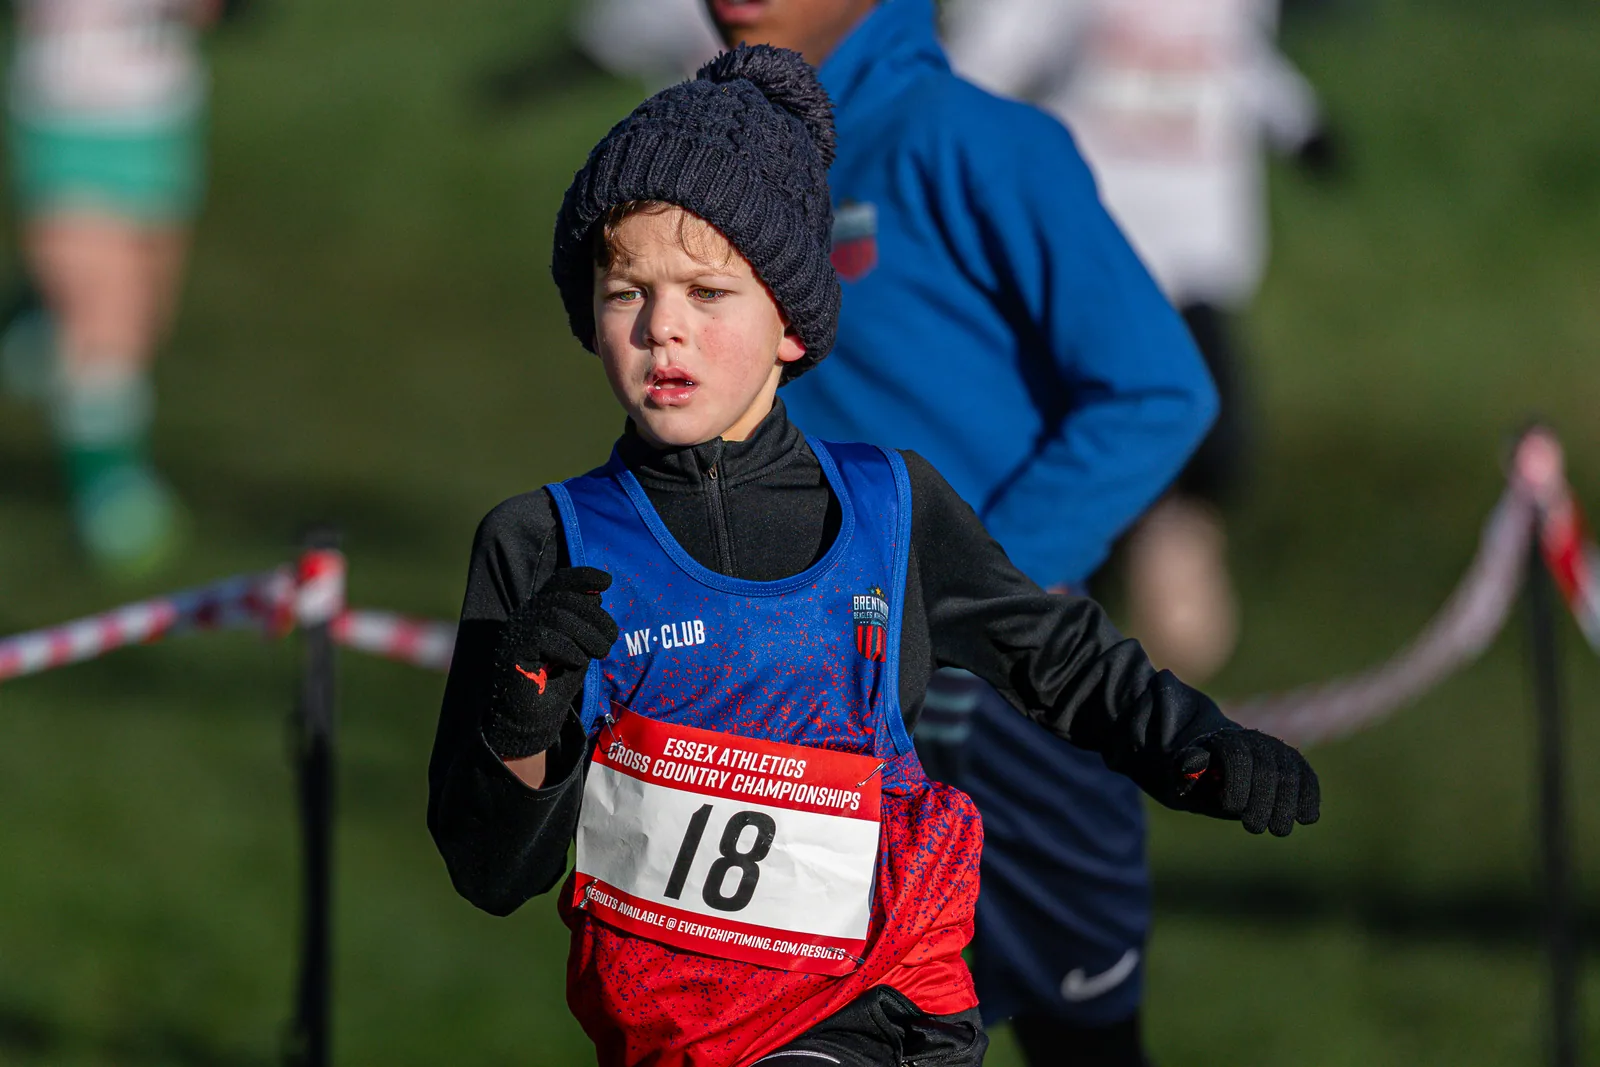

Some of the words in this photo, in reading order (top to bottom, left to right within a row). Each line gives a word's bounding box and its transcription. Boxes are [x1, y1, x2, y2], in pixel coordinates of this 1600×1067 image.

[607, 742, 651, 773] CROSS
[652, 759, 731, 790] COUNTRY
[731, 773, 861, 811] CHAMPIONSHIPS
[663, 737, 718, 764] ESSEX
[717, 748, 807, 779] ATHLETICS
[663, 803, 777, 912] 18
[618, 902, 666, 927] AVAILABLE
[666, 917, 678, 930] @
[678, 920, 846, 961] EVENTCHIPTIMING.COM/RESULTS
